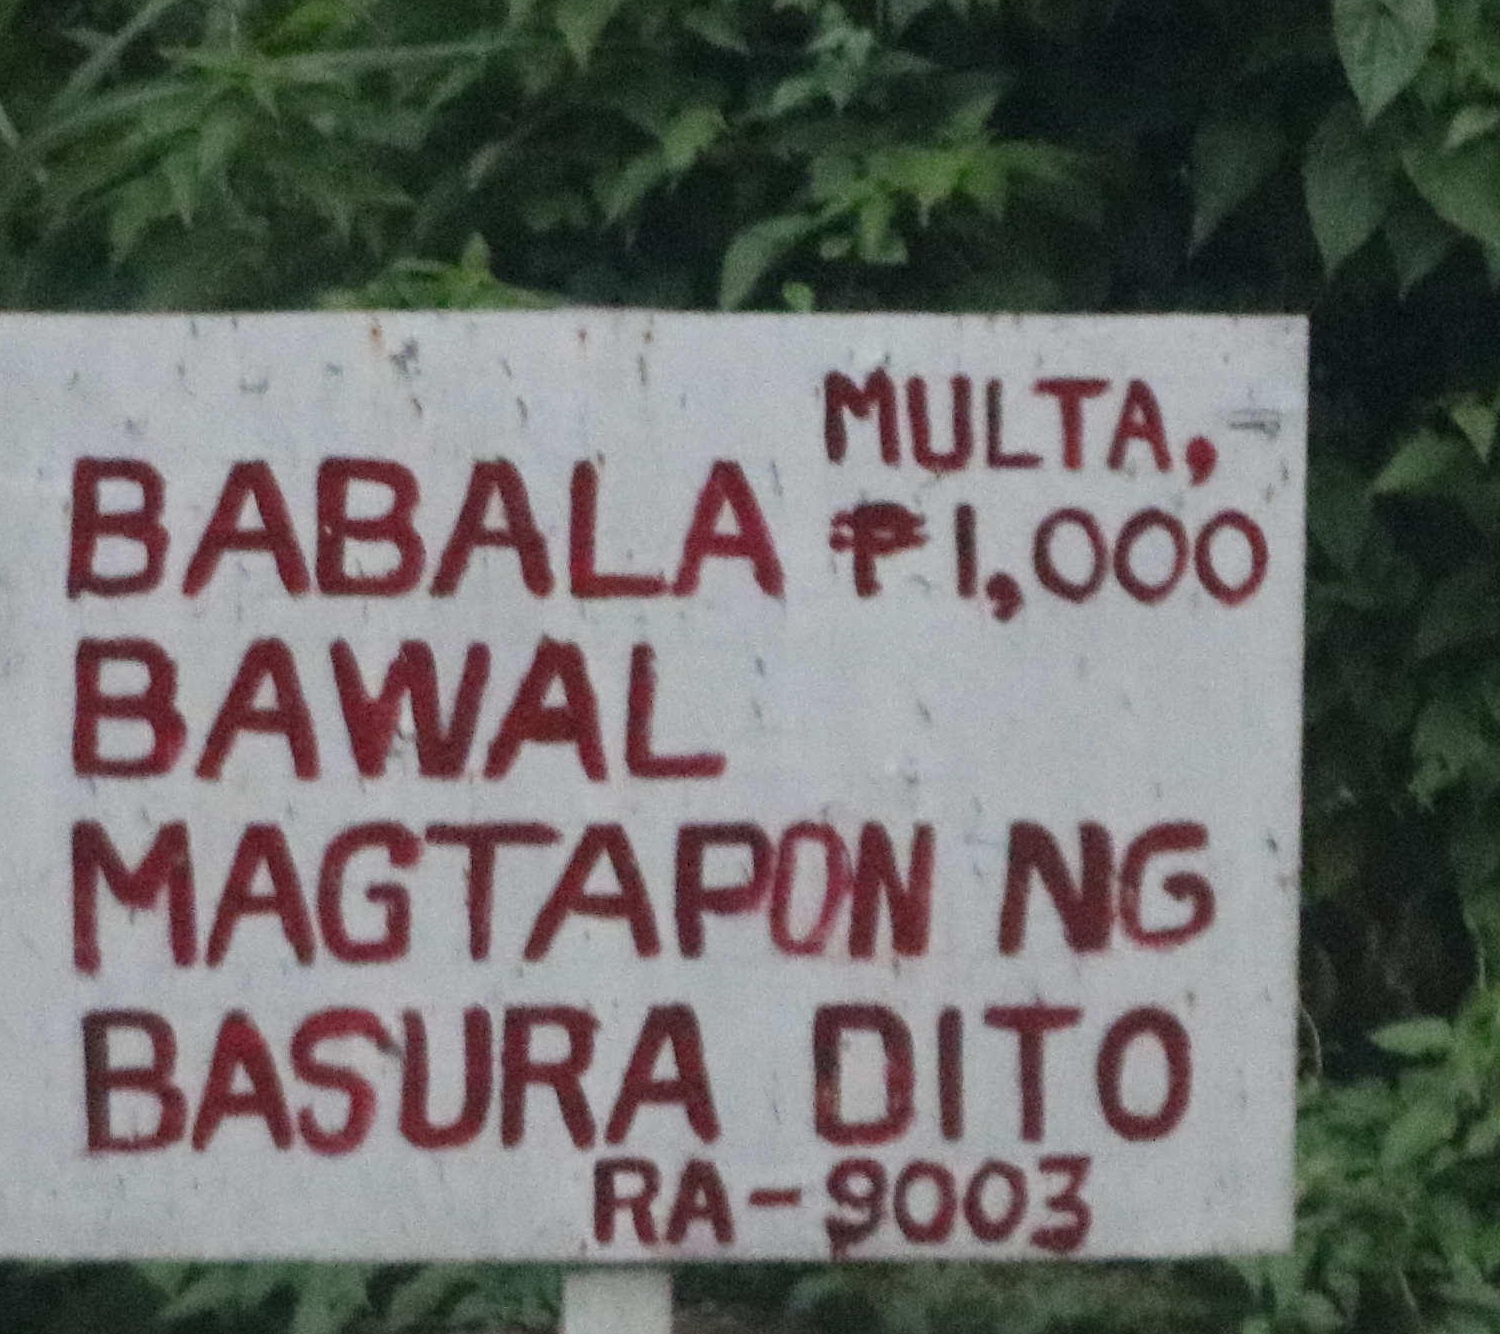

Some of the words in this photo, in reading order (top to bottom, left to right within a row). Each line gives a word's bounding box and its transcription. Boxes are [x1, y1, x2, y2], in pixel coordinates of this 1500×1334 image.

[824, 367, 1219, 486] MULTA,
[65, 457, 786, 600] BABALA
[70, 637, 728, 782] BAWAL
[70, 821, 936, 974] MAGTAPON
[998, 821, 1217, 956] NG
[82, 1004, 721, 1156] BASURA
[812, 1000, 1192, 1146] DITO
[592, 1156, 1094, 1253] RA-9003
